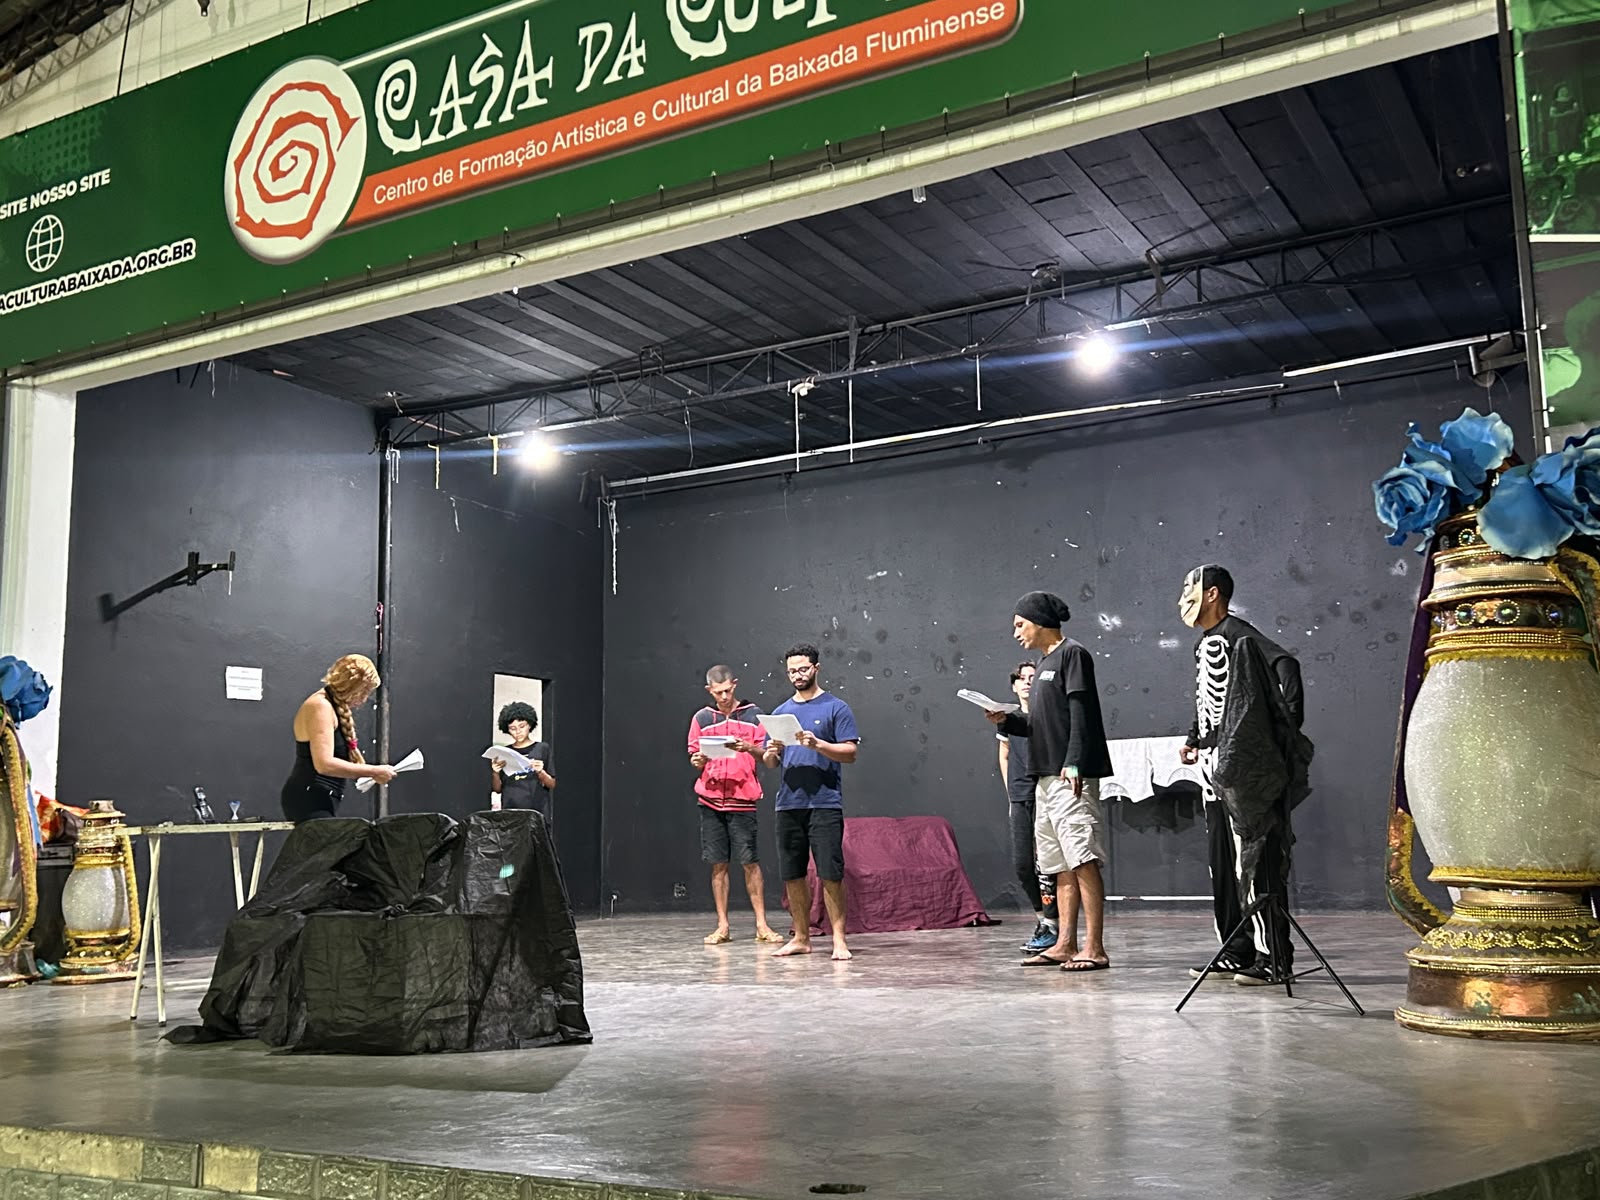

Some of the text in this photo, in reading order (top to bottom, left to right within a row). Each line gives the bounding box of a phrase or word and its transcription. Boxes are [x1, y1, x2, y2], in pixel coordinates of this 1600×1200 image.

[374, 2, 1005, 205] Centro de Formação Artística e Cultural da Baixada Fluminense
[375, 19, 554, 155] CASA
[577, 11, 647, 93] DA
[30, 181, 78, 210] NOSSO
[80, 169, 111, 192] SITE
